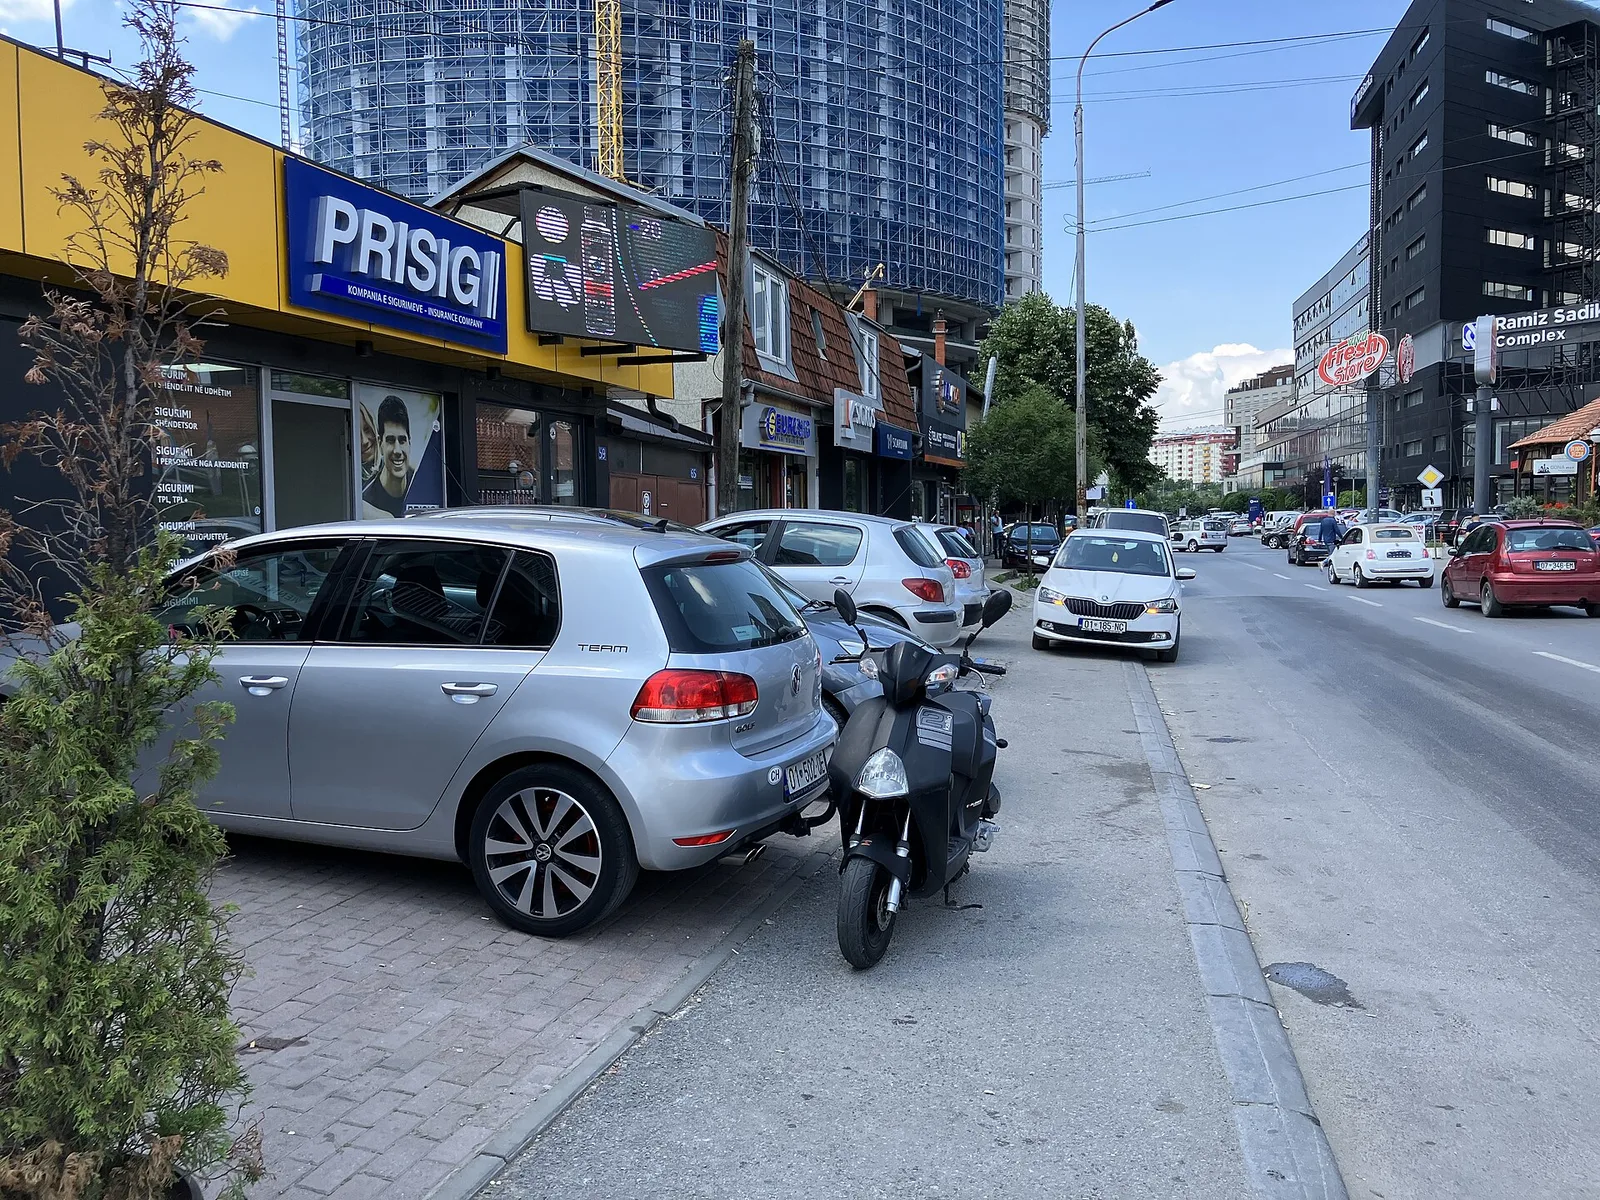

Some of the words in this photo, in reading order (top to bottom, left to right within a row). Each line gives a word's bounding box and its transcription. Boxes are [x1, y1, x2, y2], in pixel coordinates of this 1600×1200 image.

[347, 284, 382, 302] KOMPANIA
[383, 294, 387, 304] E
[388, 295, 424, 313] SIGURIMEVE
[428, 307, 458, 322] INSURANCE
[458, 315, 483, 328] COMPANY
[1496, 312, 1548, 331] Ramiz
[1496, 329, 1566, 347] Complex
[1326, 332, 1379, 368] Fresh
[1333, 356, 1376, 386] Store
[155, 407, 192, 418] SIGURIMI
[598, 446, 606, 460] 59
[214, 461, 249, 469] AKSIDENTET
[157, 483, 194, 493] SIGURIMI
[159, 521, 195, 531] SIGURIMI
[577, 643, 628, 653] TEAM
[735, 721, 755, 733] GOLF
[770, 769, 780, 781] CH
